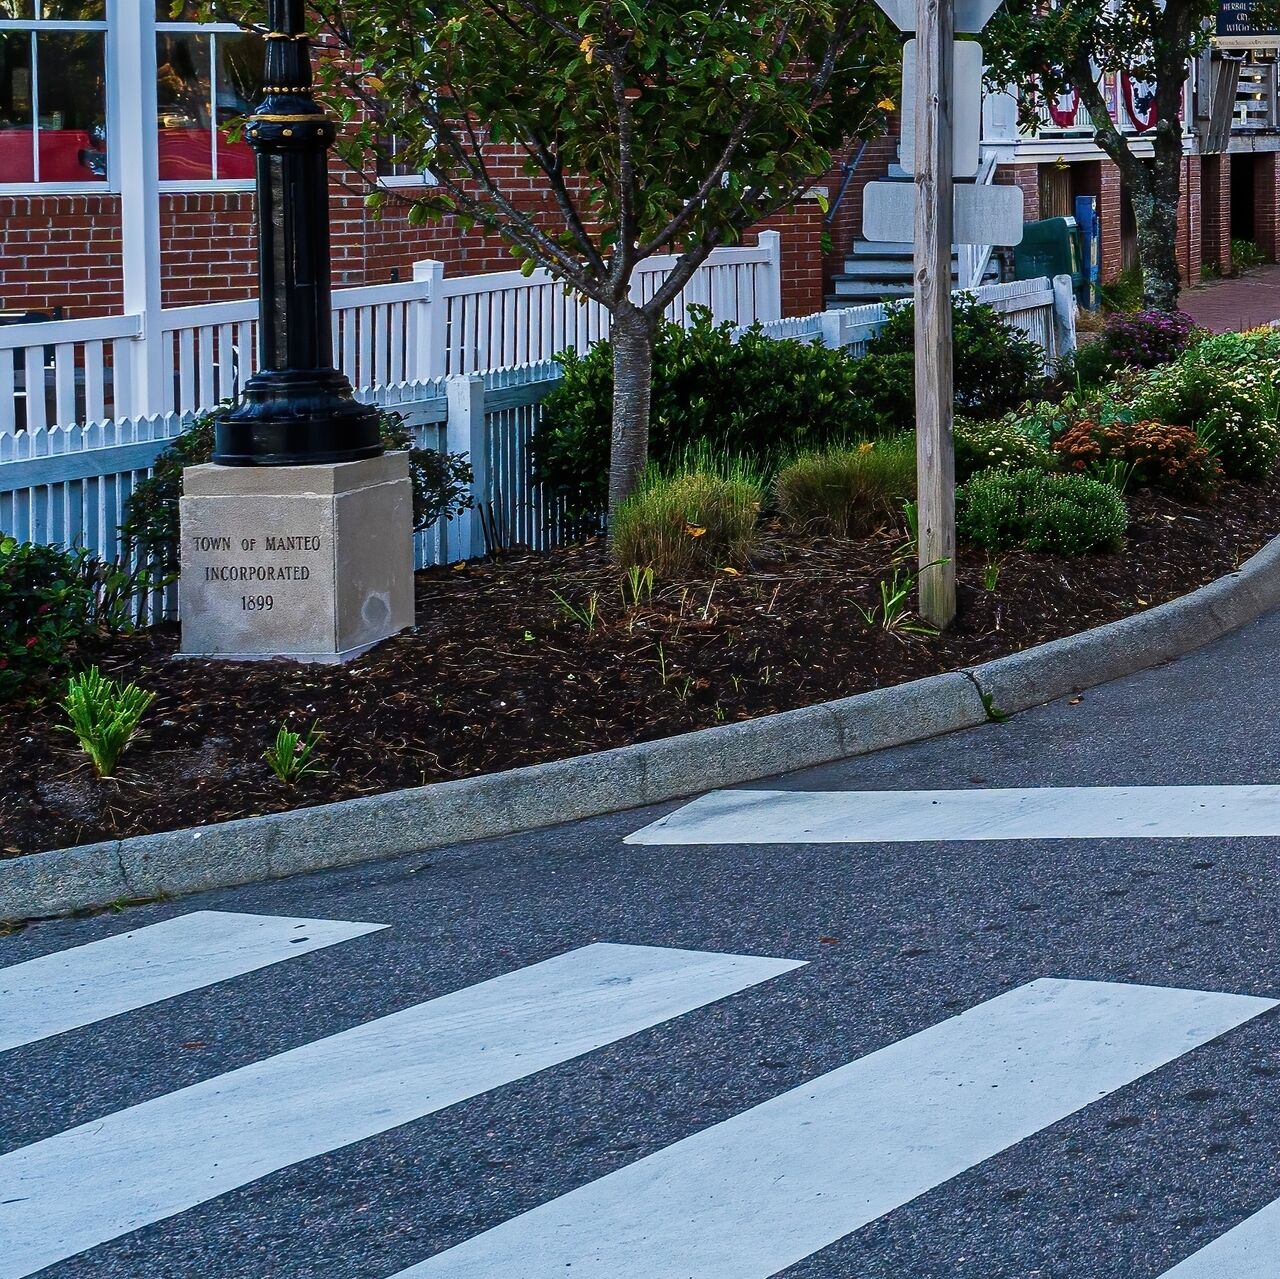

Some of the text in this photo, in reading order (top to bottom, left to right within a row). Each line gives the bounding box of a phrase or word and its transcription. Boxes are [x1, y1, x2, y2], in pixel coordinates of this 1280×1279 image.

[1223, 2, 1247, 11] HERBAL
[193, 536, 231, 552] TOWN
[265, 535, 321, 552] MANTEO
[205, 566, 310, 581] INCORPORATED
[241, 595, 274, 611] 1899
